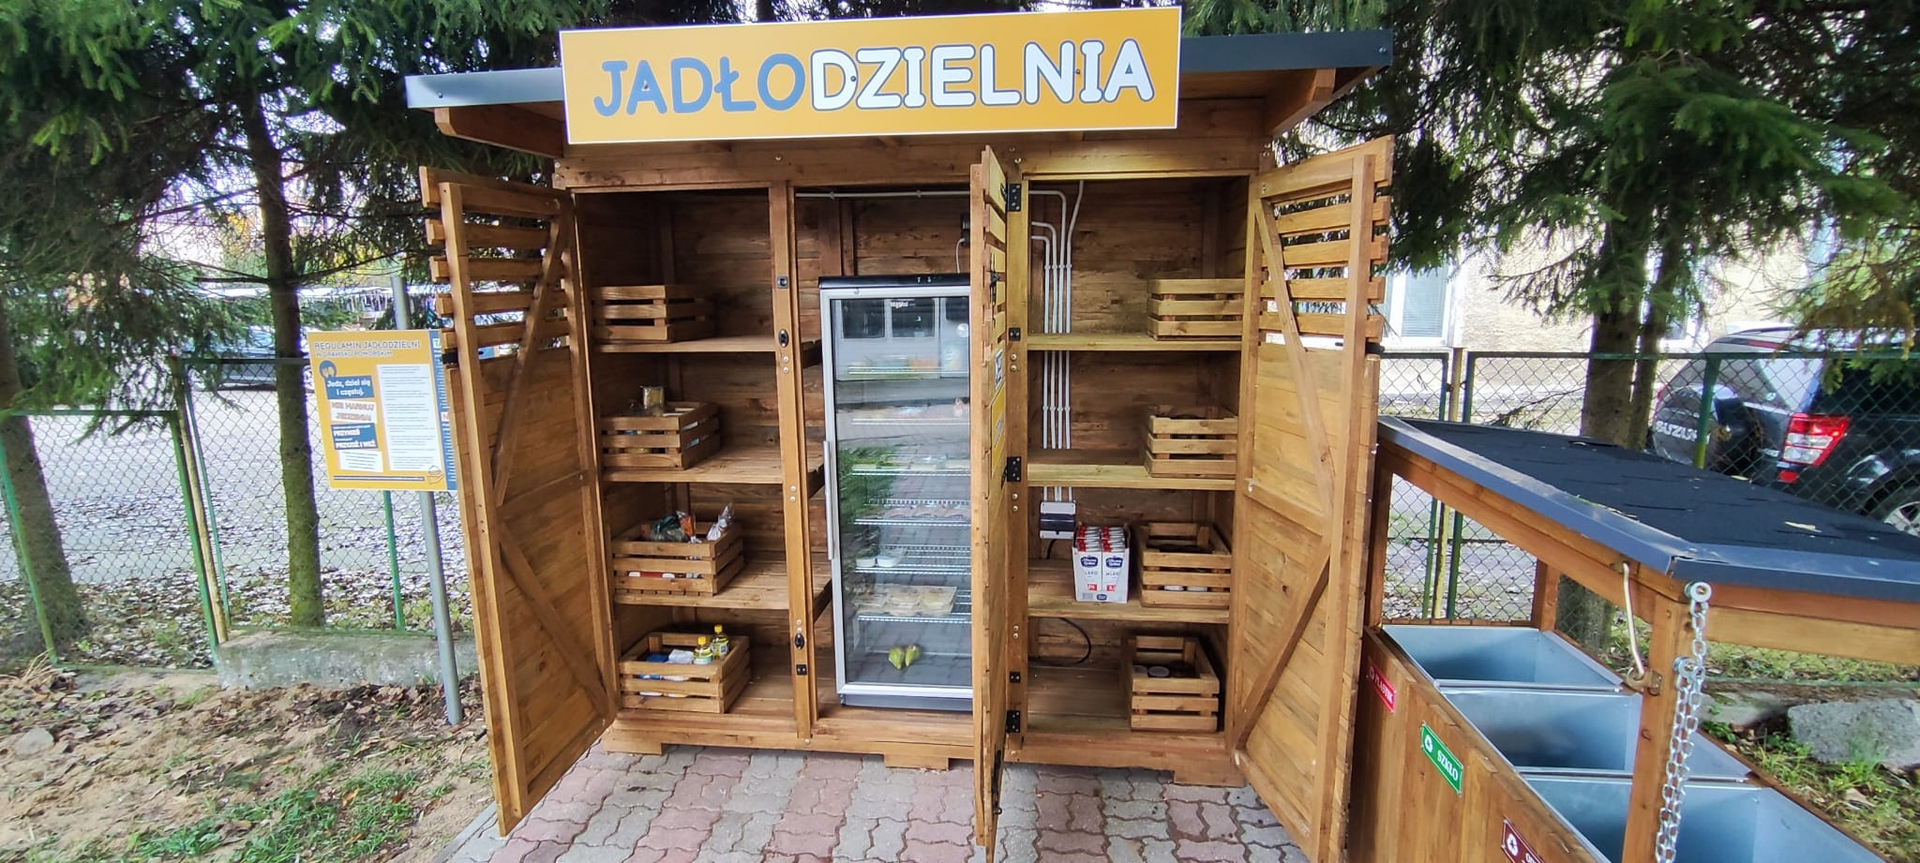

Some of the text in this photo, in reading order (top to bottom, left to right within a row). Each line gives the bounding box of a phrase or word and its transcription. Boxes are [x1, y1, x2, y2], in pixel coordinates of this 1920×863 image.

[593, 38, 1155, 117] JADŁODZIELNIA
[314, 342, 361, 350] REGULAMIN
[1437, 750, 1459, 781] SZKŁO
